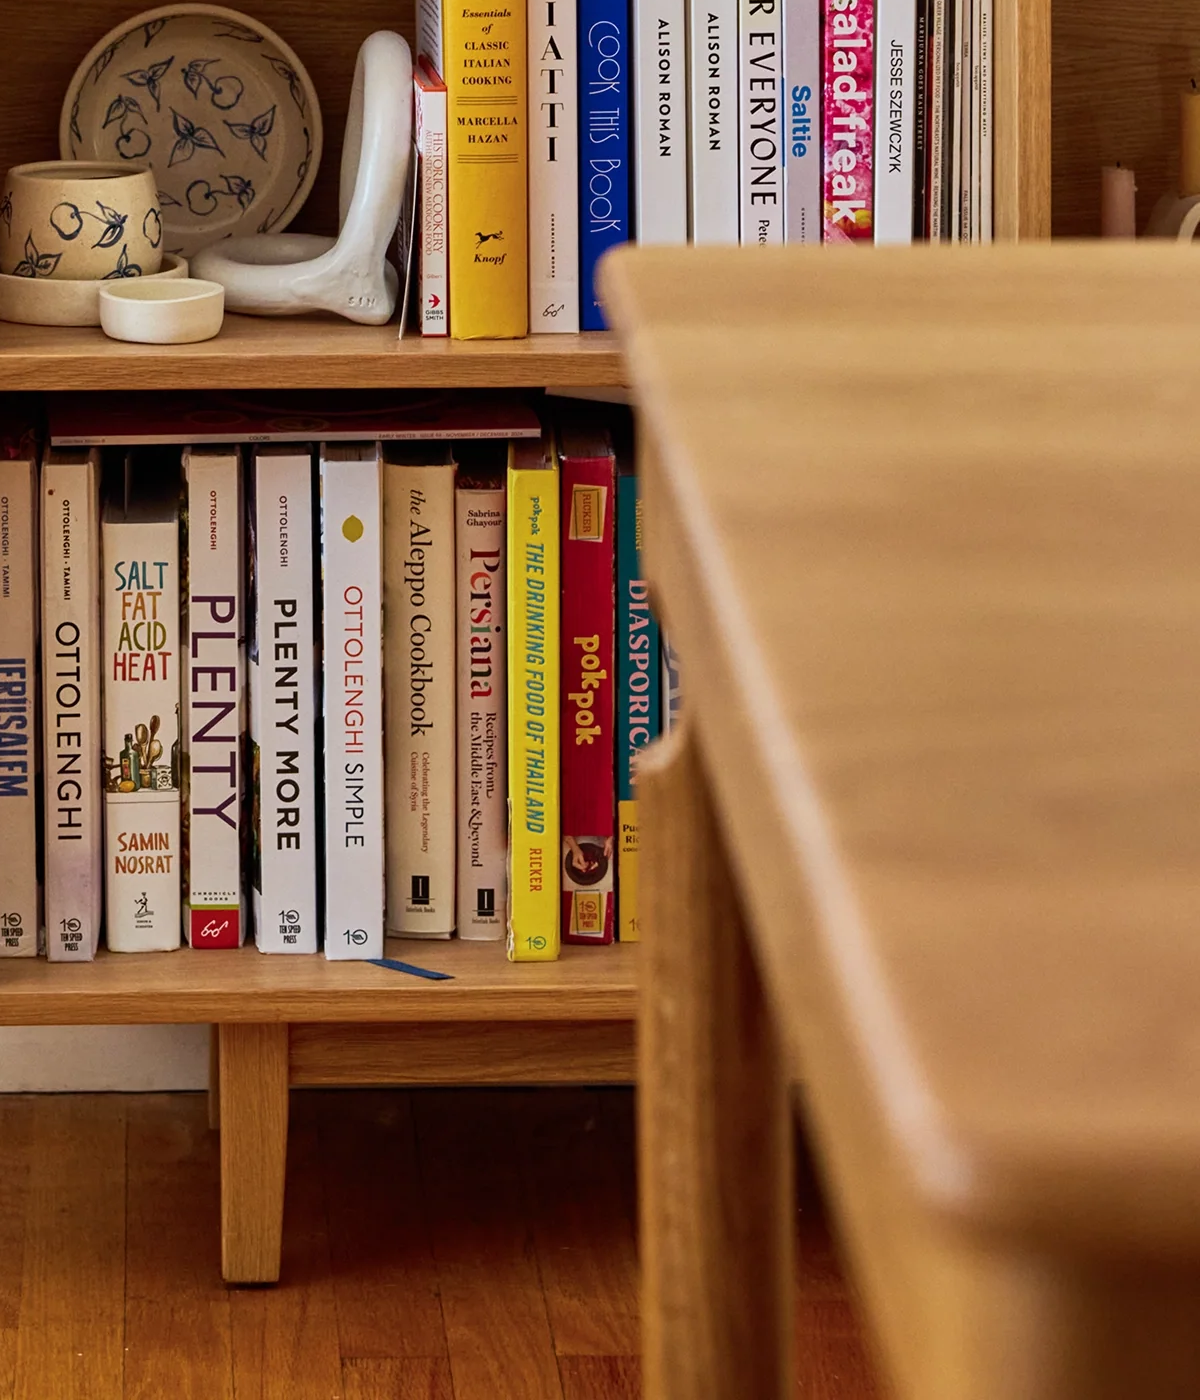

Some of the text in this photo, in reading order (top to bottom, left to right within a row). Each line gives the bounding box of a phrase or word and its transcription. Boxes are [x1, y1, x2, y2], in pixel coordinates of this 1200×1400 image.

[462, 8, 511, 18] Essentials
[481, 24, 493, 35] of
[463, 58, 510, 68] ITALIAN
[464, 41, 509, 50] CLASSIC
[588, 20, 621, 95] COOK
[462, 76, 512, 85] COOKING
[658, 18, 672, 157] ALISON ROMAN
[707, 12, 721, 151] ALISON ROMAN
[457, 116, 518, 126] MARCELLA
[749, 32, 777, 206] EVERYONE
[791, 85, 812, 158] Saltie
[888, 40, 904, 173] JESSE SZEWCZYK
[468, 134, 508, 143] HAZAN
[832, 116, 867, 224] freak
[433, 132, 444, 254] HISTORIC COOKERY
[589, 159, 622, 233] BOOK
[473, 253, 508, 265] Knopf
[209, 490, 217, 550] OTTOLENGHI
[279, 495, 288, 567] OTTOLENGHI
[466, 518, 502, 528] Ghayour
[467, 509, 501, 518] Sabrina
[582, 493, 592, 533] RICKER
[0, 496, 10, 598] OTTOLENGHI TAMIMI
[62, 499, 71, 601] OTTOLENGHI TAMIMI
[526, 543, 545, 575] THE
[114, 560, 169, 592] SALT
[121, 591, 162, 621] FAT
[404, 489, 434, 737] the Aleppo Cookbook
[470, 548, 501, 700] Persiana
[525, 577, 545, 666] DRINKING
[118, 621, 167, 651] ACID
[113, 651, 172, 681] HEAT
[191, 595, 237, 830] PLENTY
[525, 668, 545, 717] FOOD
[55, 621, 82, 840] OTTOLENGHI
[273, 599, 300, 850] PLENTY MORE
[343, 585, 365, 848] OTTOLENGHI SIMPLE
[470, 712, 482, 733] the
[525, 721, 545, 744] OF
[470, 733, 483, 778] Middle
[483, 712, 498, 799] Recipes from
[409, 751, 419, 812] Cuisine of Syria
[420, 751, 430, 854] Celebrating the Legendary
[470, 780, 482, 806] East
[525, 746, 545, 834] THAILAND
[117, 832, 170, 852] SAMIN
[115, 855, 173, 874] NOSRAT
[529, 847, 543, 892] RICKER
[1, 927, 23, 937] TEN SPEED
[5, 937, 19, 947] PRESS
[60, 932, 83, 942] TEN SPEED
[64, 942, 79, 951] PRESS
[279, 924, 301, 934] TEN SPEED
[283, 934, 297, 944] PRESS
